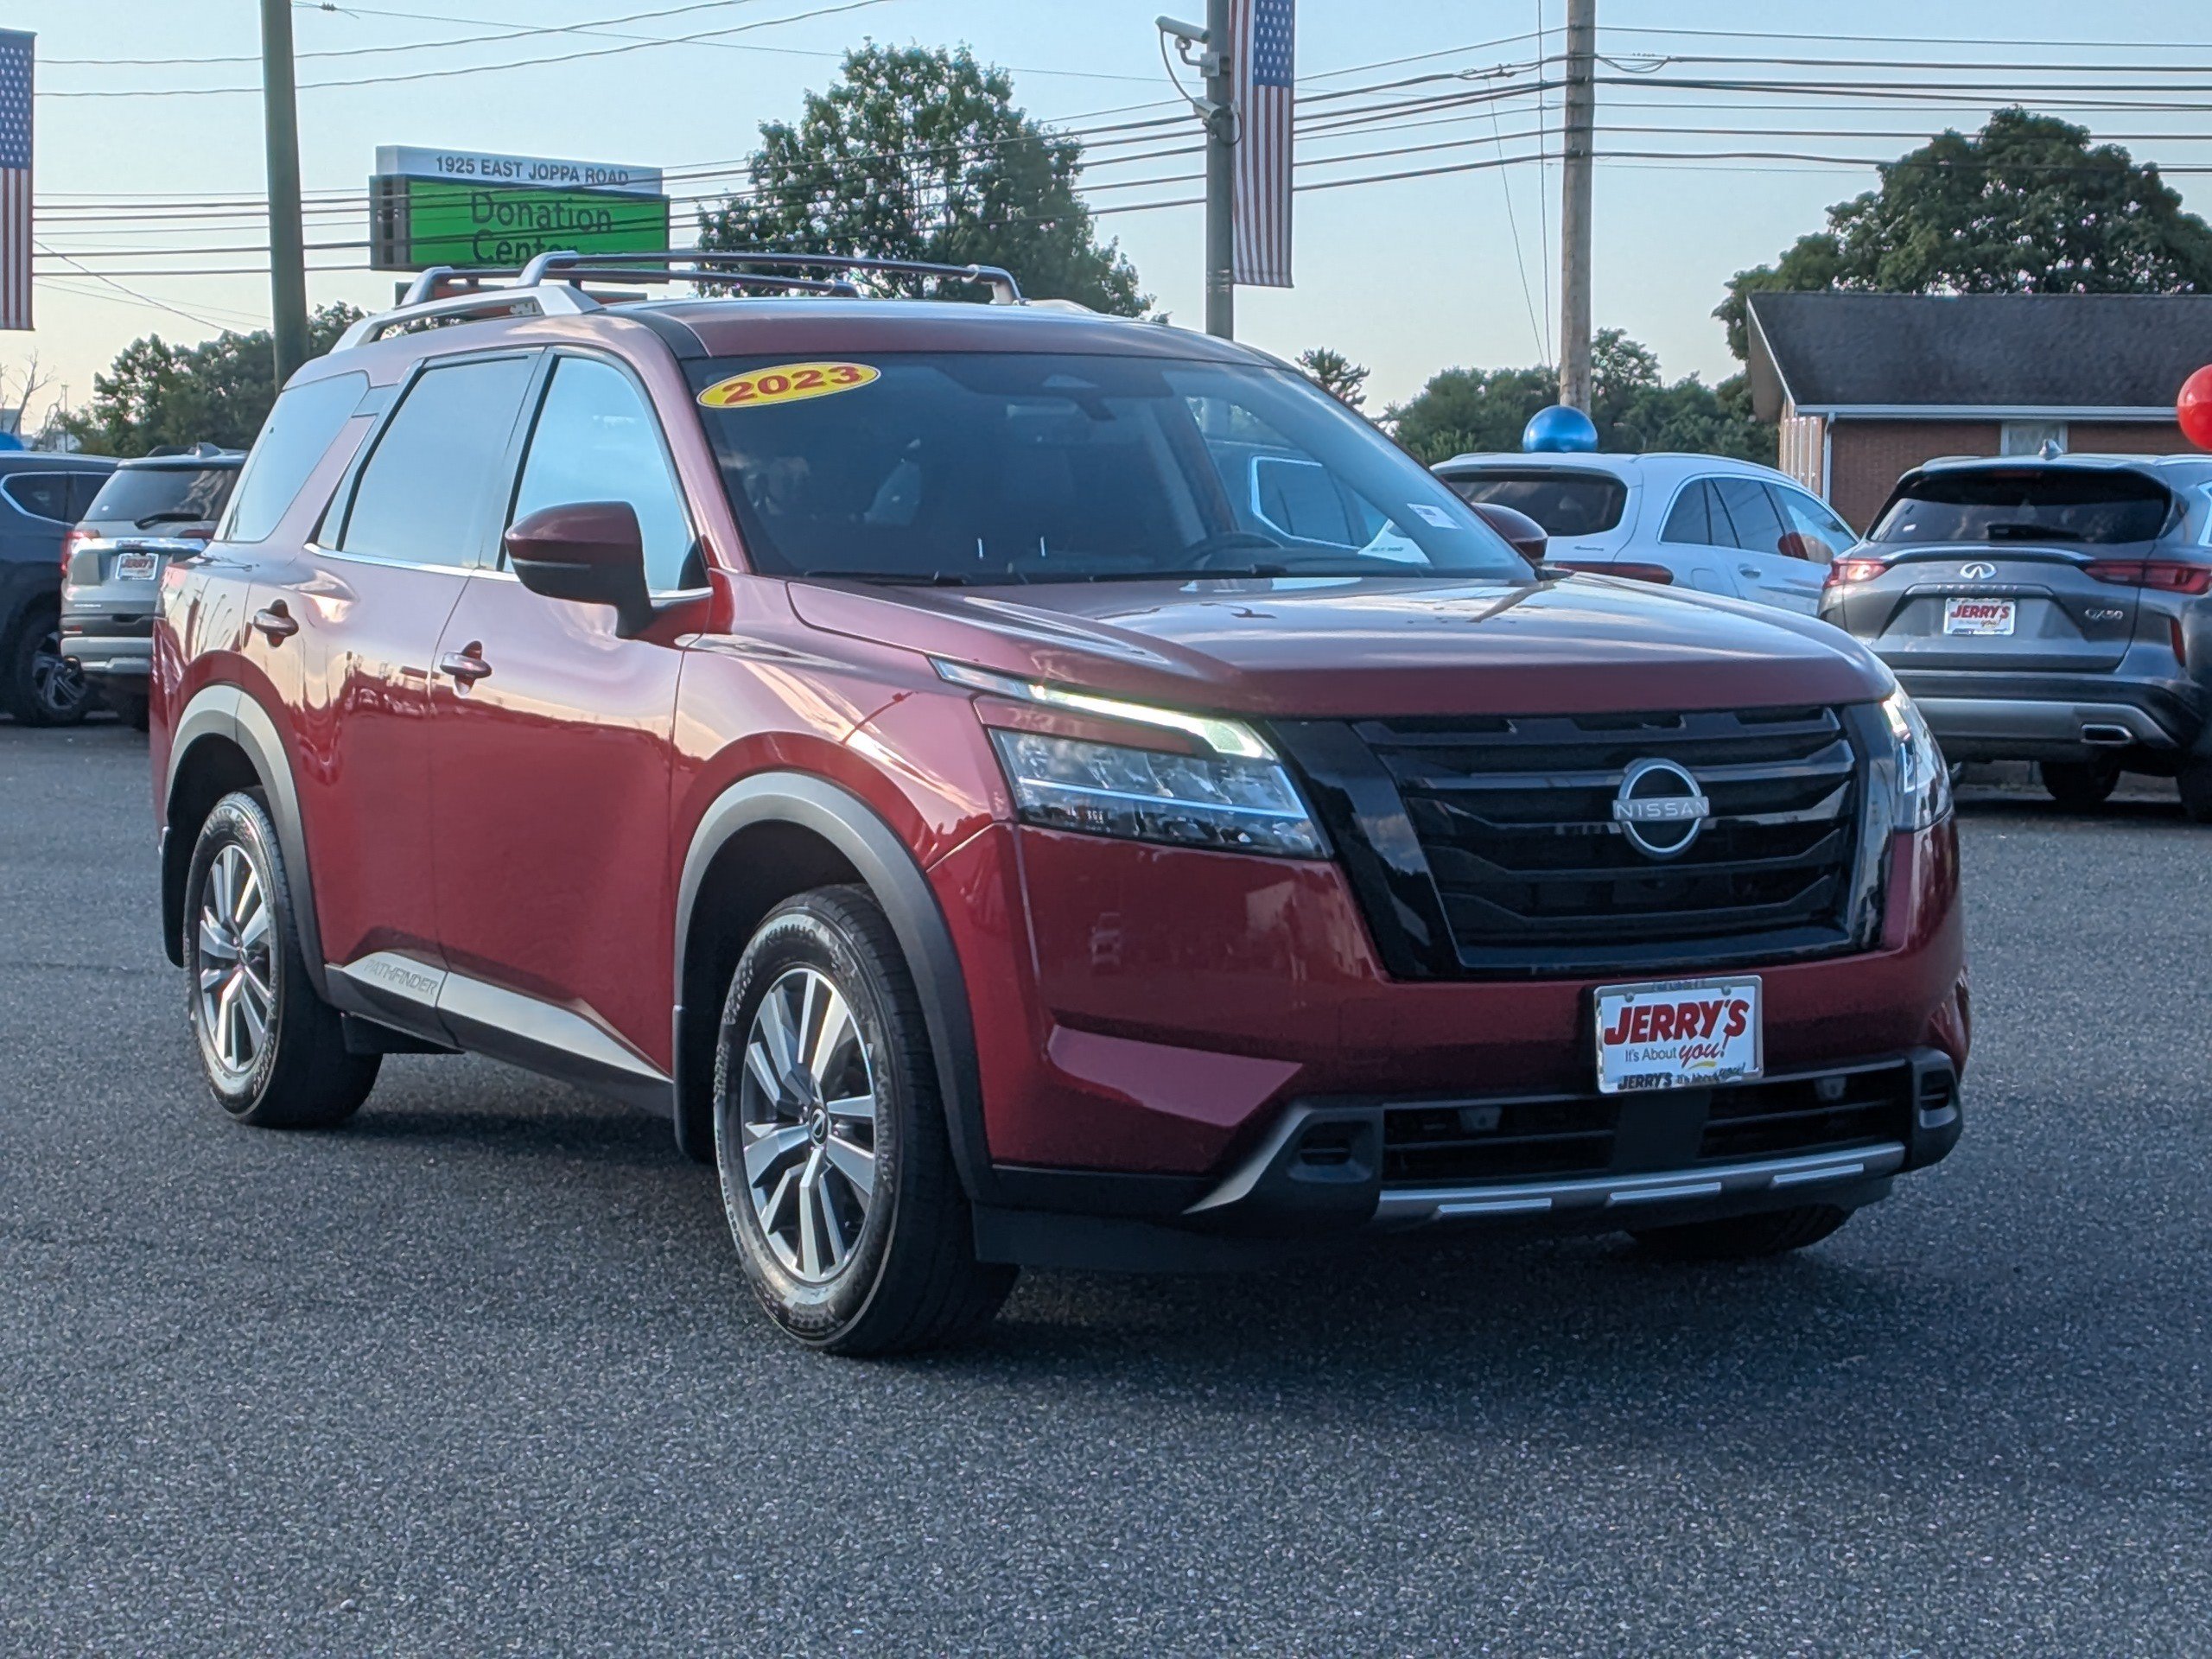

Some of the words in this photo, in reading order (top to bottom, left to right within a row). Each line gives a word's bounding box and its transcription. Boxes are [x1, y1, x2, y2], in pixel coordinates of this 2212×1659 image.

[436, 156, 475, 174] 1925
[480, 159, 523, 178] EAST
[528, 163, 580, 181] JOPPA
[585, 168, 629, 184] ROAD
[471, 192, 612, 232] Donation
[722, 365, 863, 404] 2023
[1950, 605, 2011, 619] JERRY'S
[1616, 801, 1709, 818] NISSAN
[363, 959, 439, 996] PATHFINDER
[1604, 999, 1751, 1046] JERRY'S
[1625, 1049, 1640, 1062] It's
[1642, 1047, 1677, 1059] About
[1679, 1035, 1728, 1069] you!
[1618, 1071, 1673, 1090] JERRY'S
